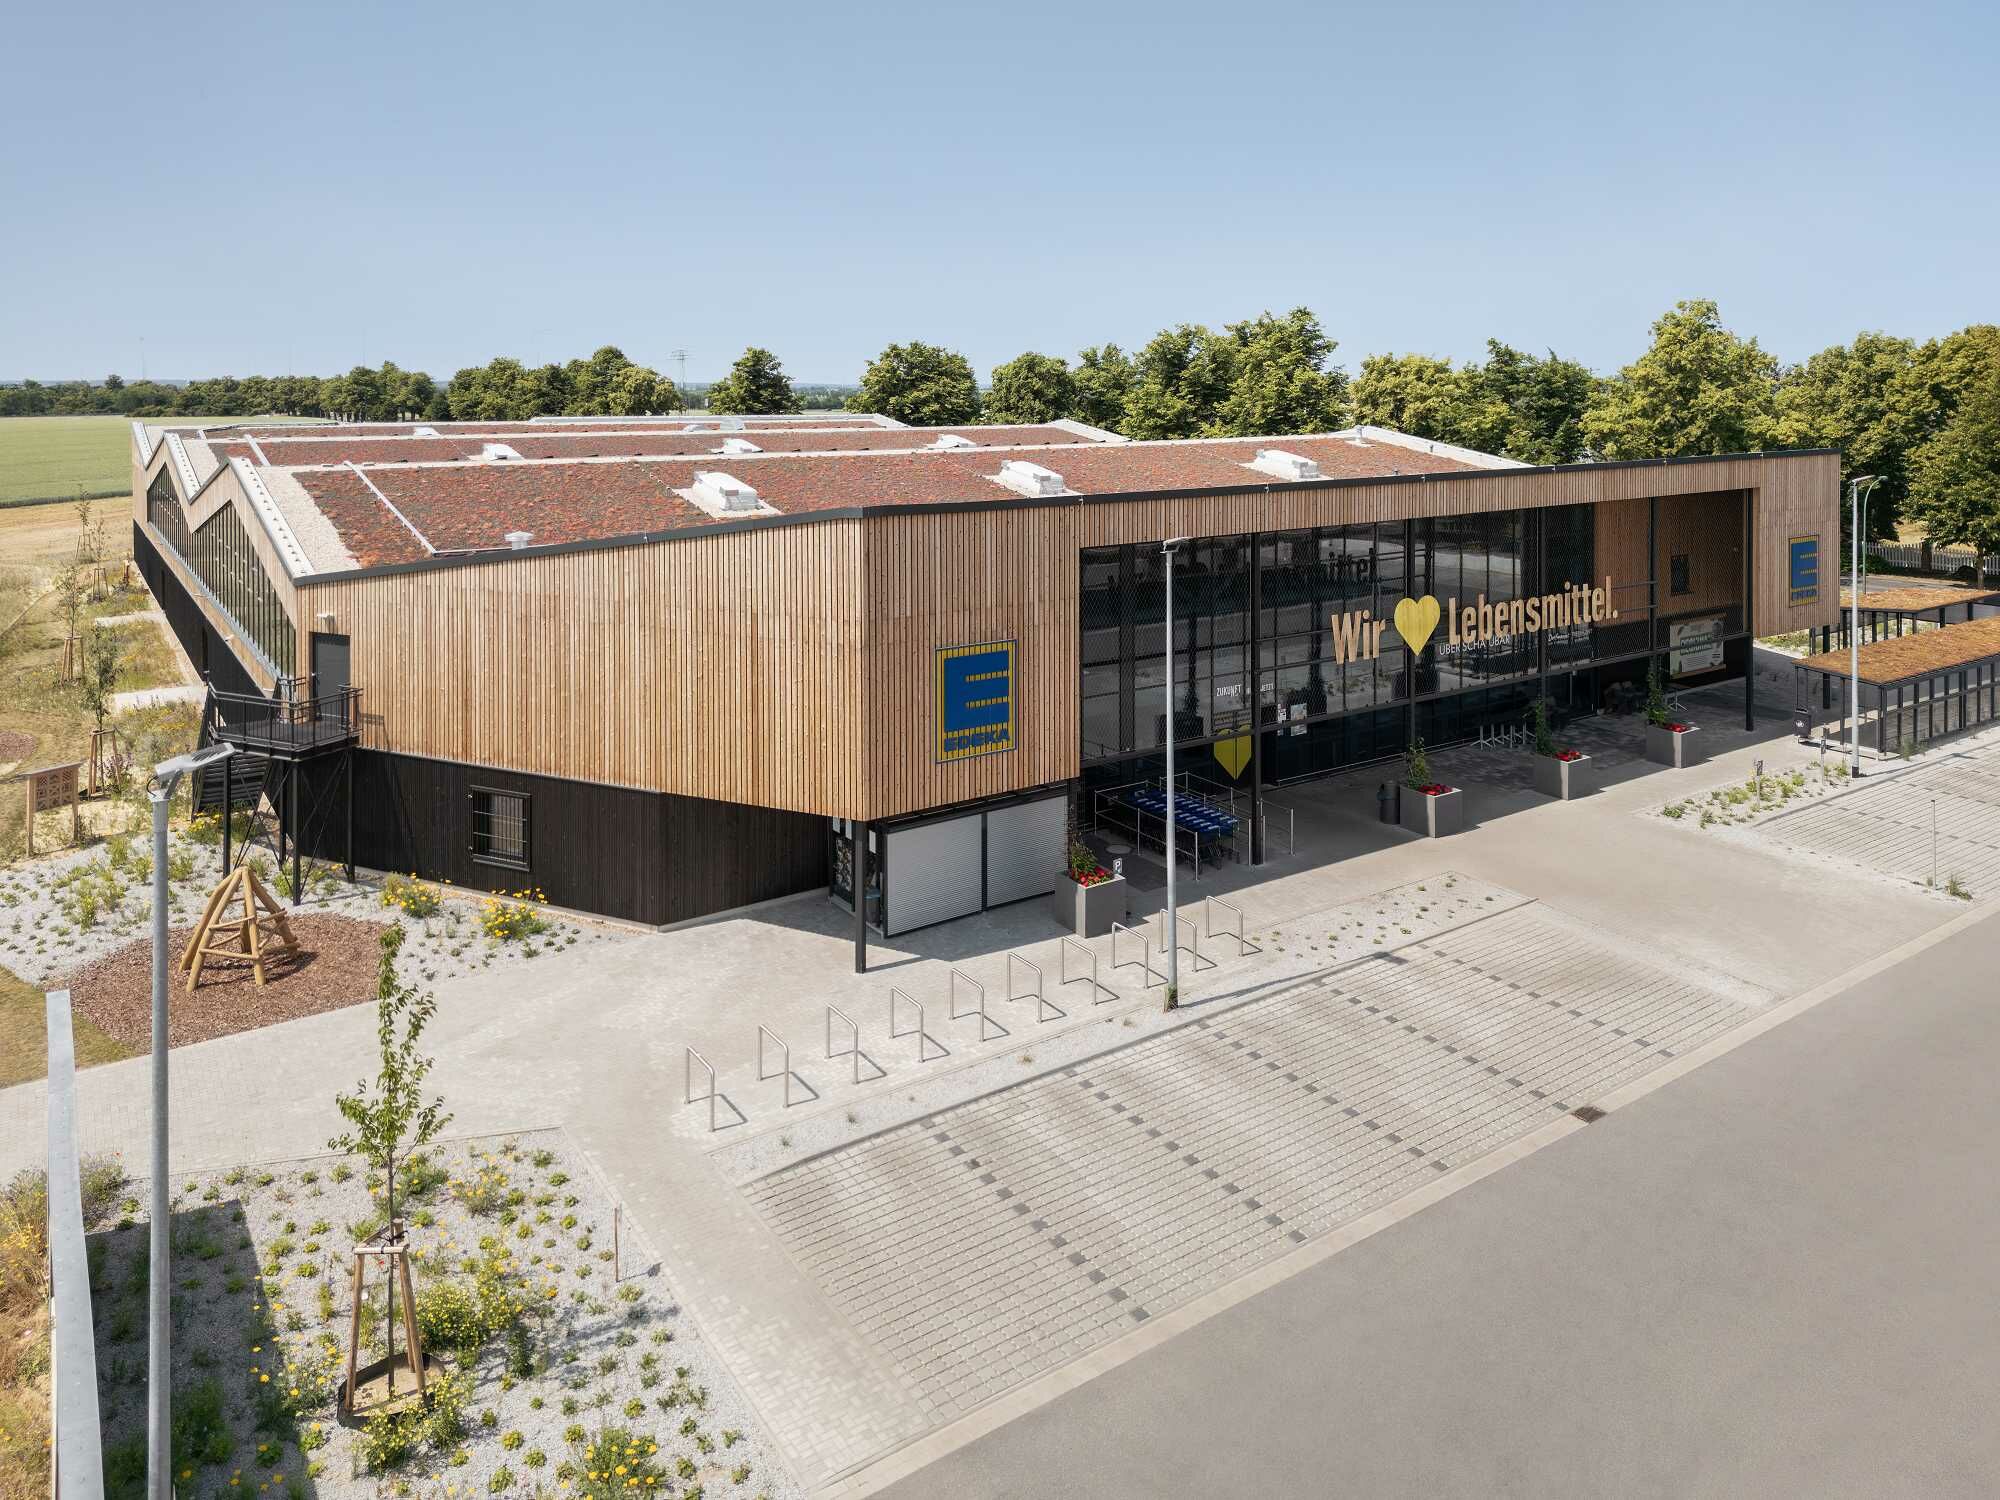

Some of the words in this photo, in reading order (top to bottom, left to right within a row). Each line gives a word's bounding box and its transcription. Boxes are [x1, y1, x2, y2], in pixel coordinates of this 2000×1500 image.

[1331, 609, 1386, 665] Wir
[1448, 575, 1619, 646] Lebensmittel.
[944, 728, 1011, 752] EDEKA
